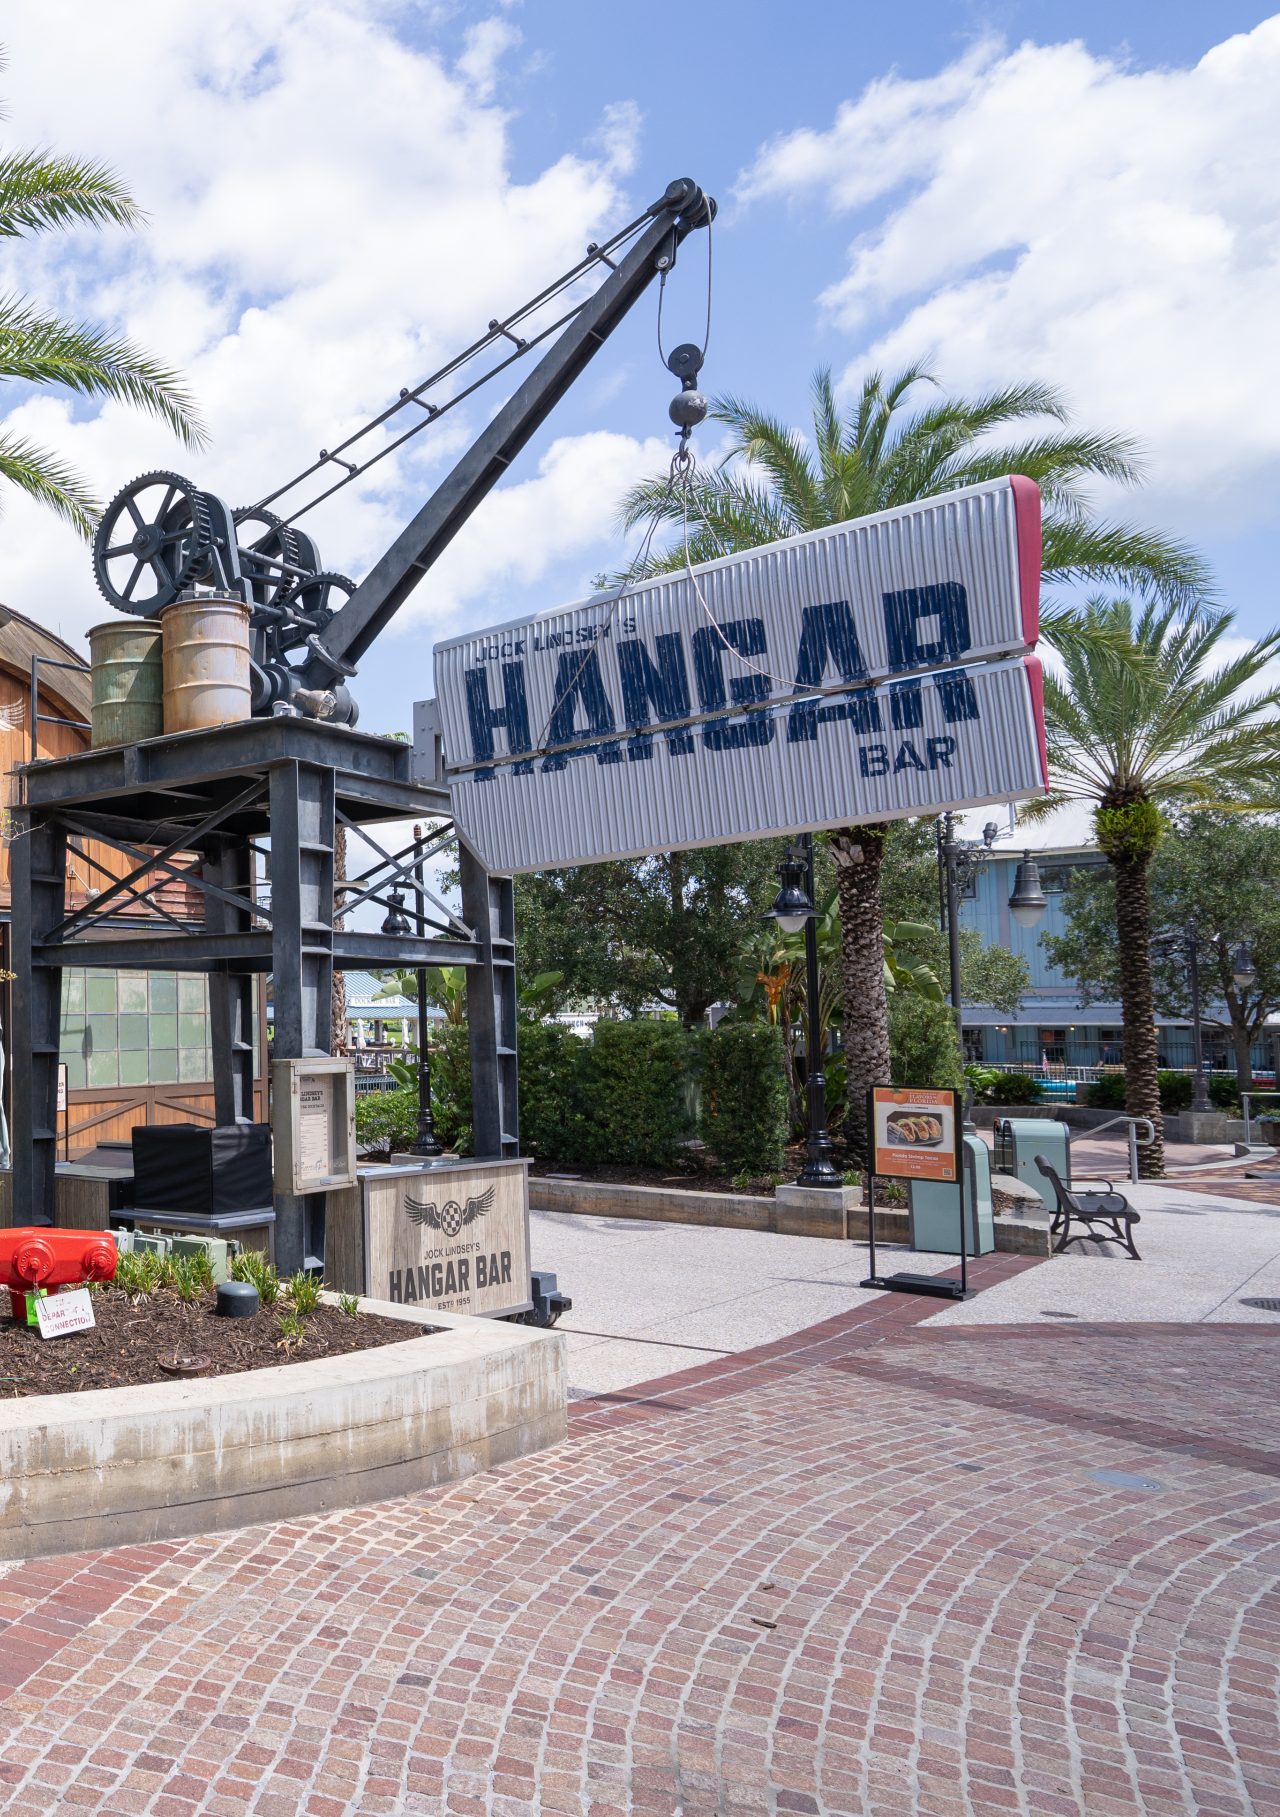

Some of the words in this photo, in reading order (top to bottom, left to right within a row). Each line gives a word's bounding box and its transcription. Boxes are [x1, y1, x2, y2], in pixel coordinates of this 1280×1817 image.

[476, 639, 525, 663] JOCK
[465, 581, 980, 781] HANGAR
[858, 735, 957, 778] BAR
[424, 1247, 444, 1261] JOCK
[445, 1242, 480, 1256] LINDSEY'S
[389, 1258, 470, 1305] HANGAR
[475, 1250, 512, 1289] BAR
[456, 1296, 471, 1307] 1955
